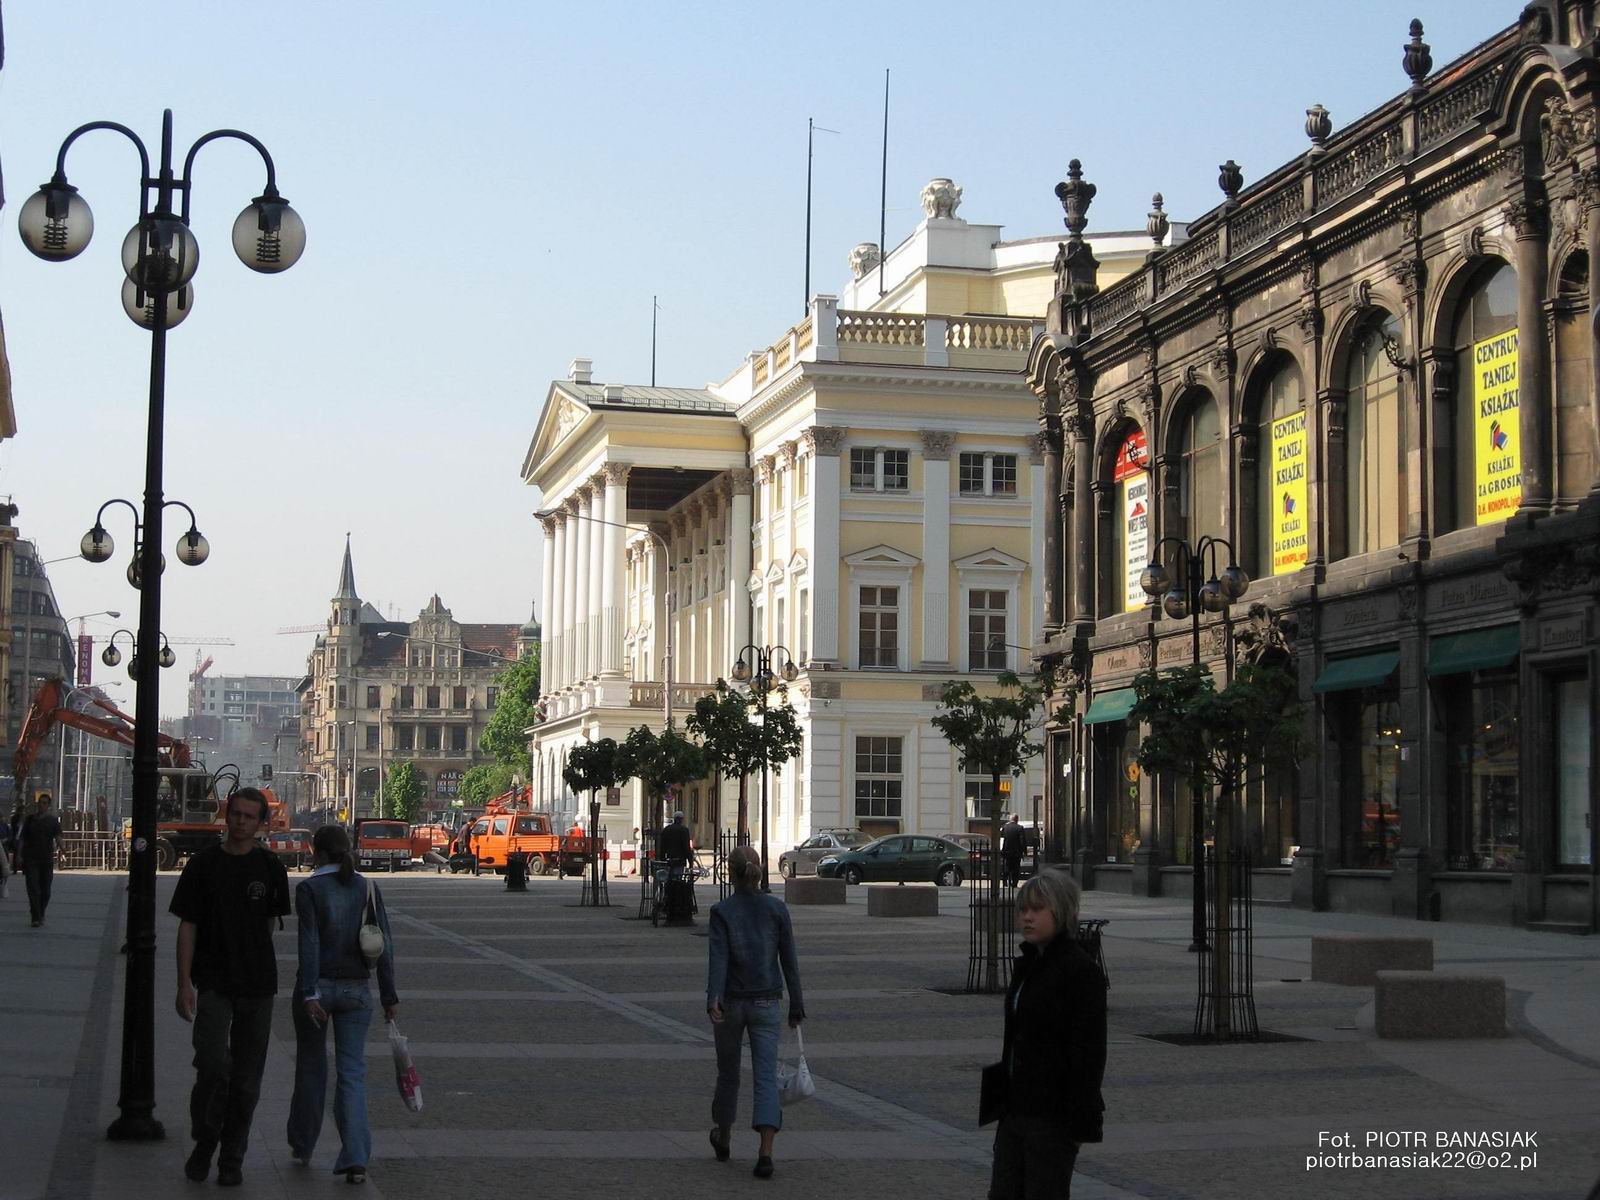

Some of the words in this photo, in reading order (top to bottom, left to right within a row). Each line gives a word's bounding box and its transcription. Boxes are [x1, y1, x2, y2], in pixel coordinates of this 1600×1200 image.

[1482, 362, 1516, 389] TANIEJ
[1481, 388, 1519, 418] KSIĄŻKI
[1274, 415, 1306, 440] CENTRUM
[1278, 439, 1302, 462] TANIEJ
[1276, 461, 1304, 486] KSIĄŻKI
[1488, 455, 1514, 475] KSIĄŻKI
[1478, 484, 1487, 497] ZA
[1543, 626, 1580, 645] Kantor
[81, 636, 89, 684] RENOMA
